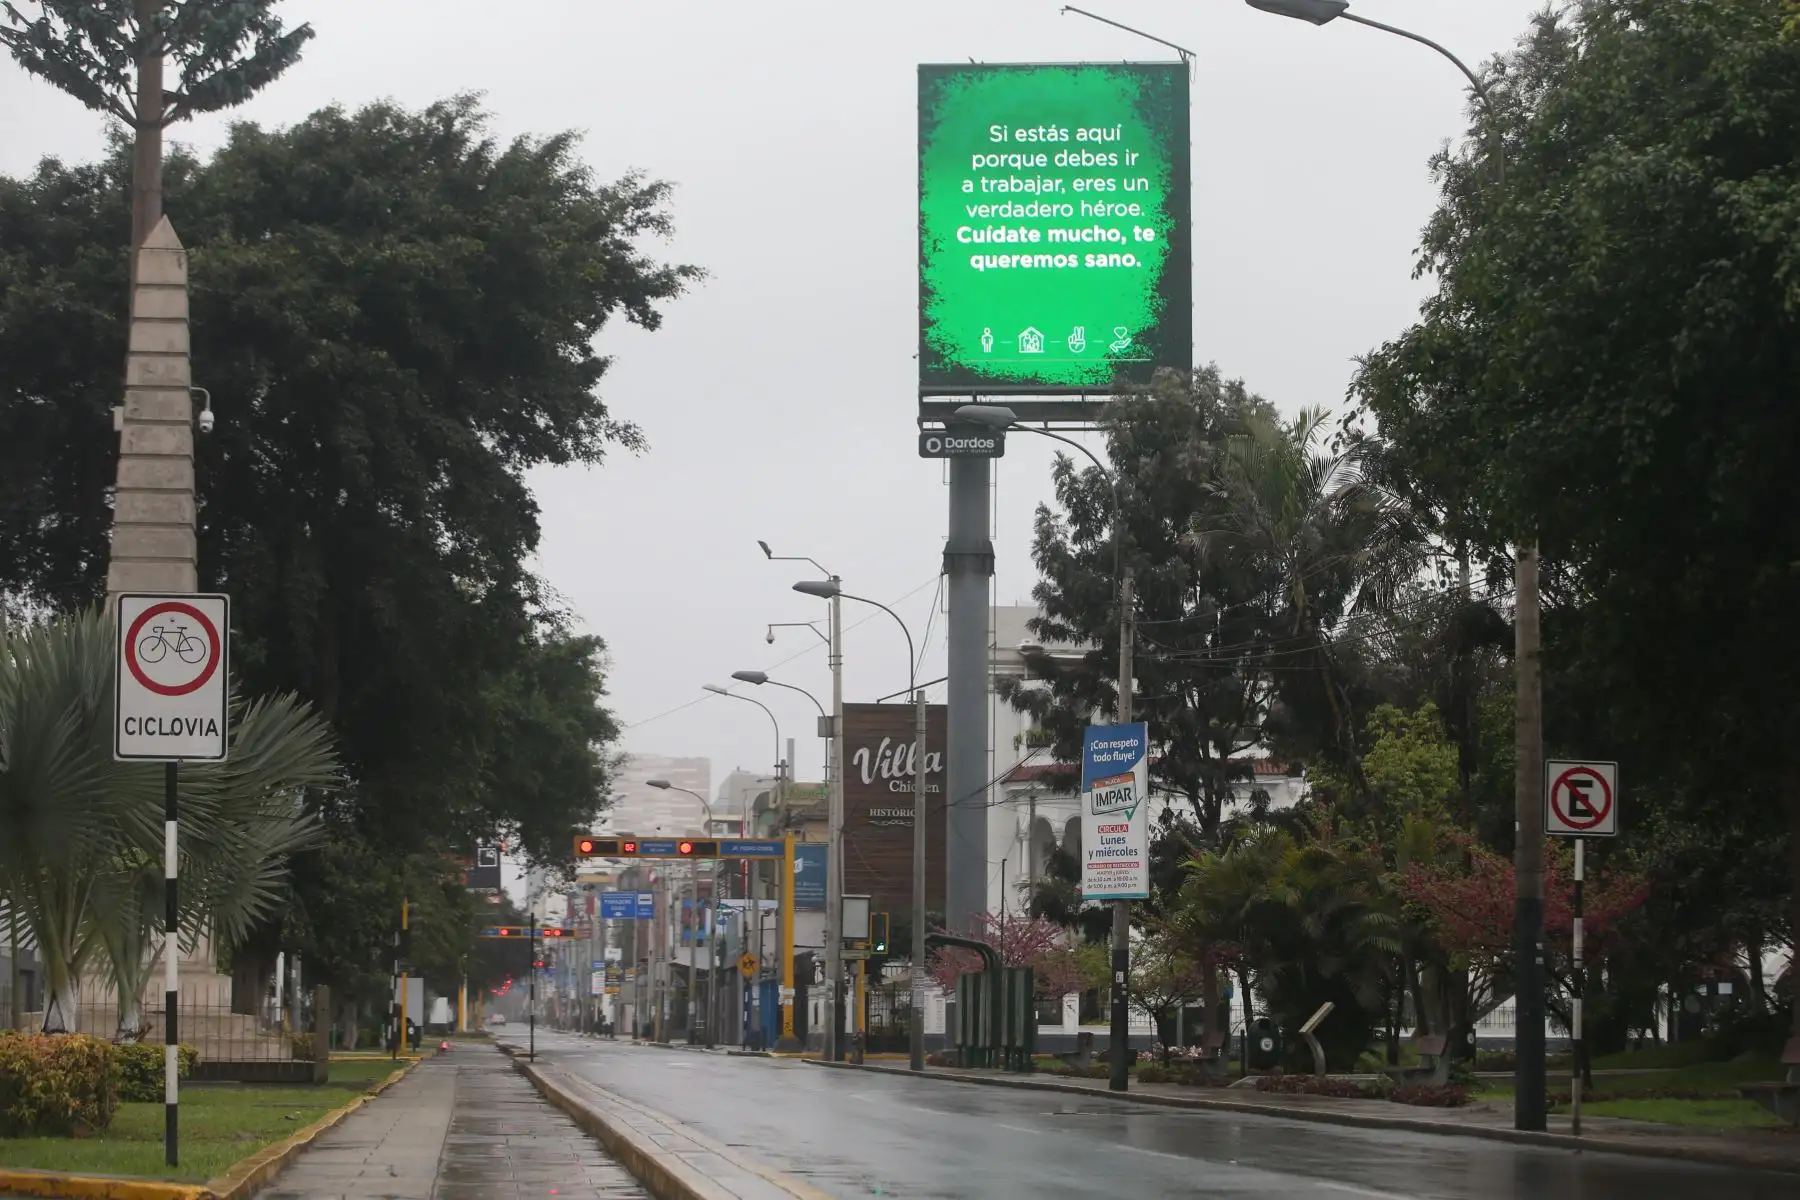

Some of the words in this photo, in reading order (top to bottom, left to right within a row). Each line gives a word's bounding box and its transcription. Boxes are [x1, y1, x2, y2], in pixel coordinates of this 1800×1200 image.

[989, 124, 1008, 142] Si
[1015, 124, 1069, 142] estás
[1076, 123, 1122, 144] aquí
[972, 153, 1048, 171] porque
[1054, 149, 1118, 167] debes
[1125, 149, 1139, 166] ir
[961, 179, 974, 193] a
[981, 175, 1066, 196] trabajar,
[1072, 177, 1116, 192] eres
[1123, 177, 1149, 191] un
[966, 200, 1073, 218] verdadero
[1080, 199, 1145, 217] héroe.
[956, 224, 1041, 243] Cuídate
[1048, 224, 1127, 245] mucho,
[1133, 225, 1155, 242] te
[970, 253, 1078, 272] queremos
[1085, 253, 1142, 267] sano.
[945, 437, 995, 448] Dardos
[124, 717, 219, 737] CICLOVIA
[1090, 740, 1108, 751] ¡Con
[1110, 738, 1139, 750] respeto
[1093, 752, 1111, 762] todo
[1113, 750, 1135, 762] fluye!
[889, 780, 940, 792] Chicen
[1096, 787, 1133, 807] IMPAR
[1099, 825, 1128, 833] CIRCULA
[1100, 836, 1126, 845] Lunes
[1088, 849, 1094, 860] y
[1096, 846, 1138, 858] miércoles
